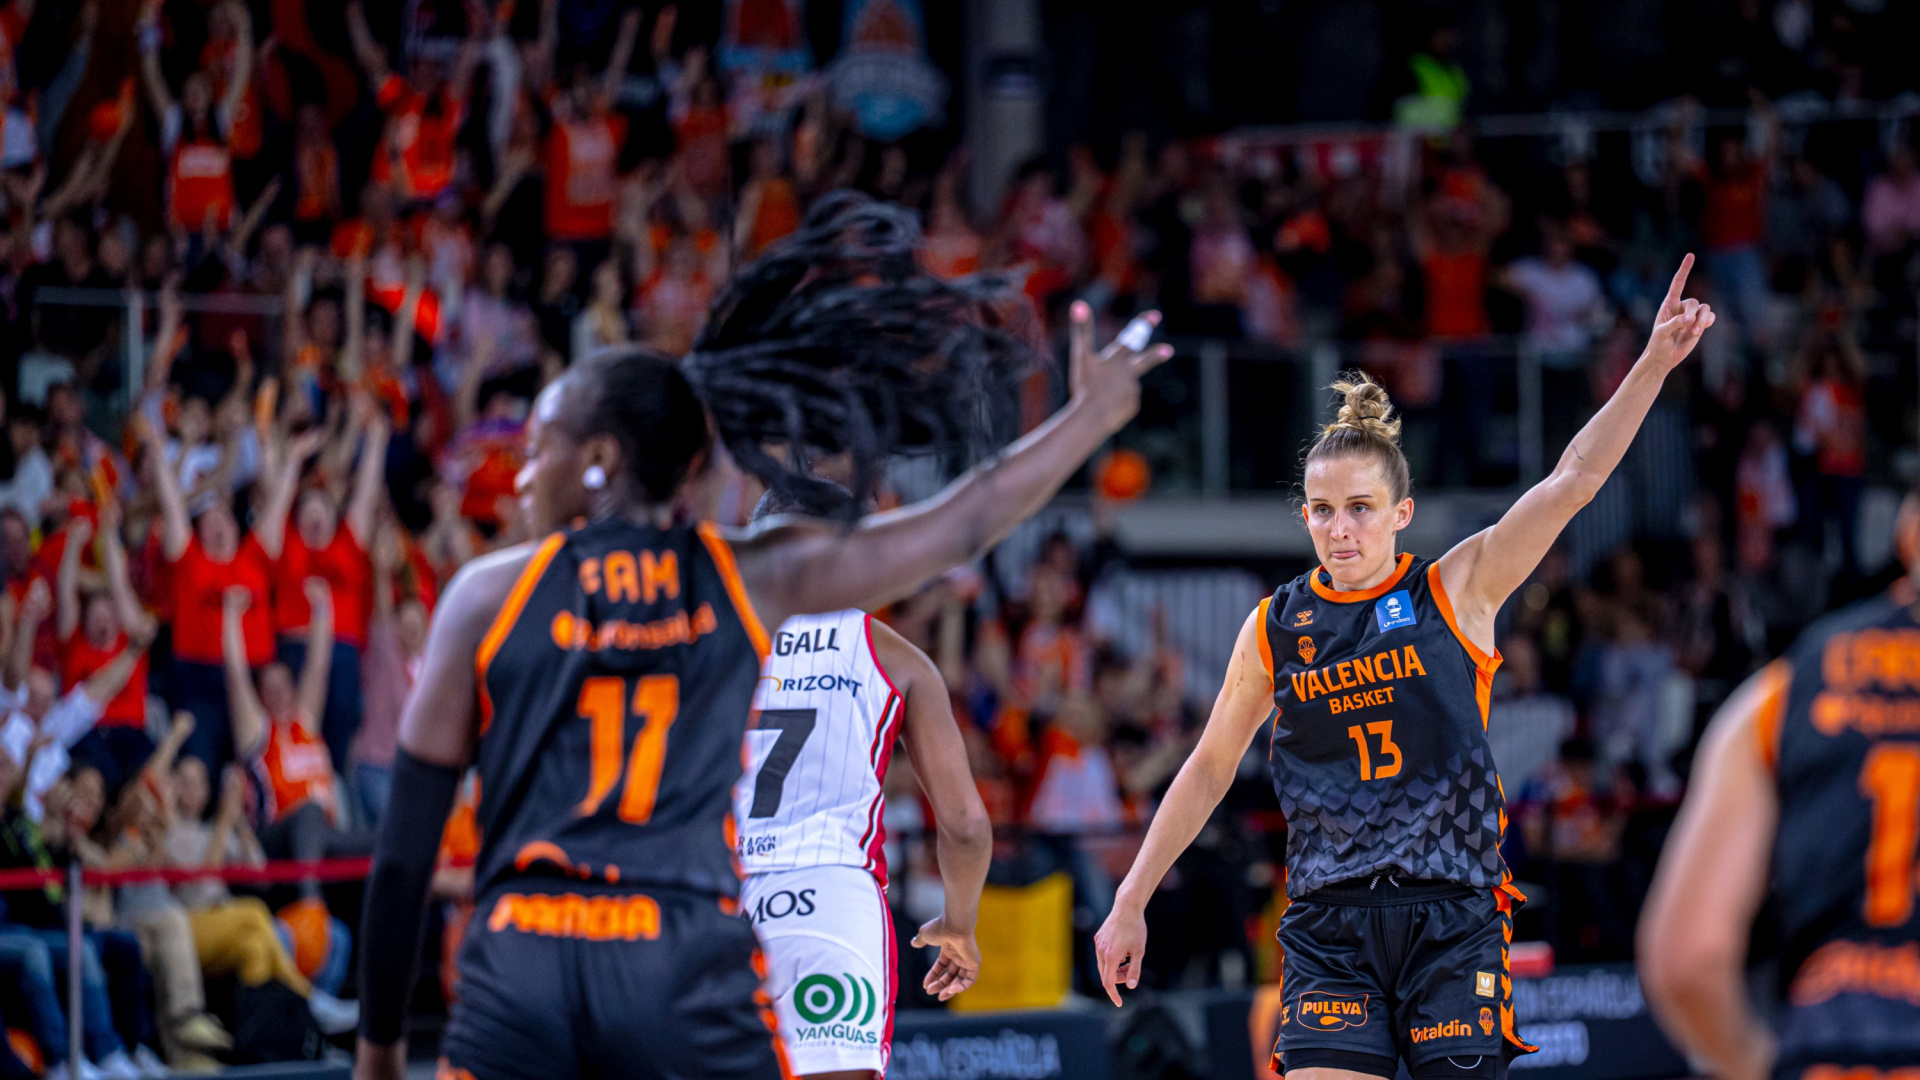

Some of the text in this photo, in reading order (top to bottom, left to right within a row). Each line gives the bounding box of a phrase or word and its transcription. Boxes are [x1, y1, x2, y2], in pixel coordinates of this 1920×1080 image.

[775, 627, 840, 657] GALL
[1292, 645, 1427, 703] VALENCIA
[1329, 687, 1395, 715] BASKET
[577, 674, 678, 825] 11
[748, 708, 817, 819] 7
[1348, 720, 1403, 781] 13
[1301, 1001, 1362, 1015] PULEVA
[796, 1024, 878, 1044] YANGUAS
[1410, 1019, 1472, 1044] Vitaldin
